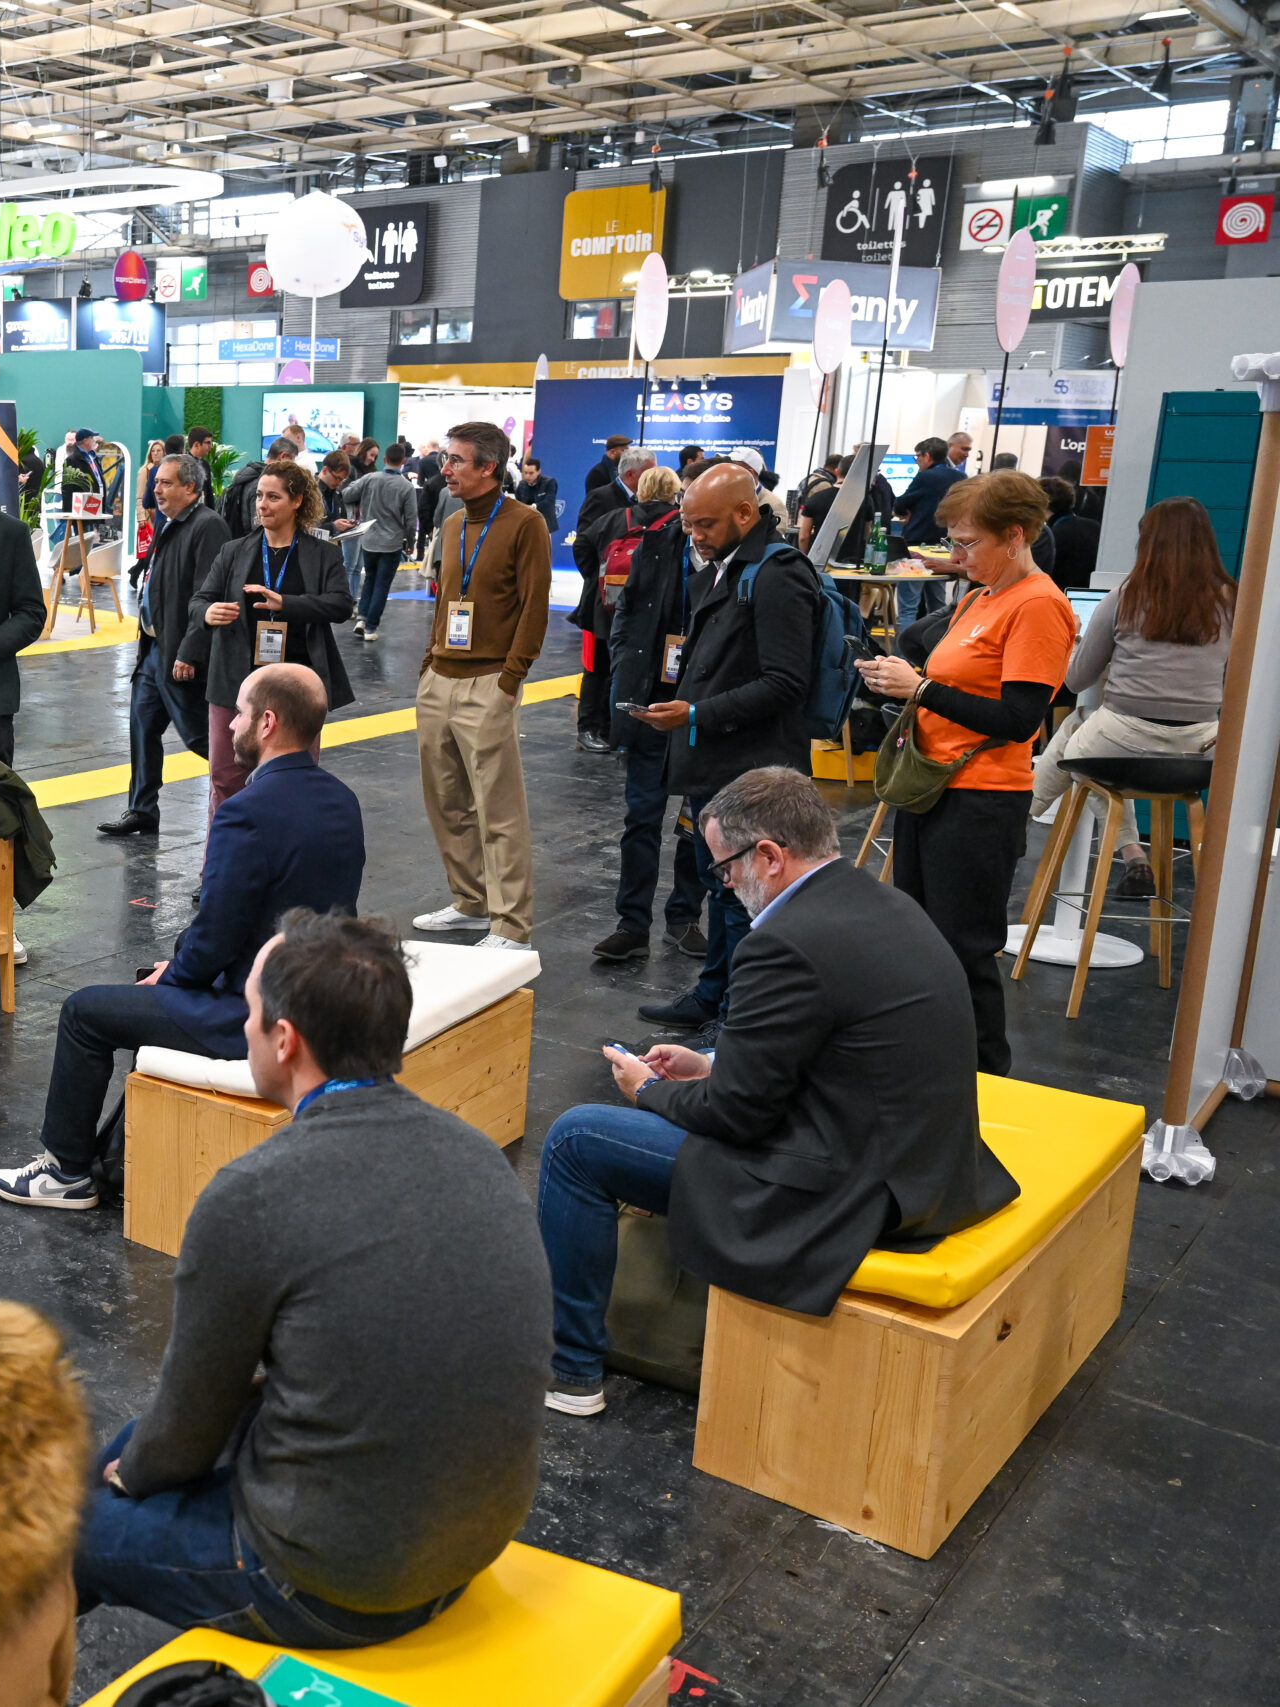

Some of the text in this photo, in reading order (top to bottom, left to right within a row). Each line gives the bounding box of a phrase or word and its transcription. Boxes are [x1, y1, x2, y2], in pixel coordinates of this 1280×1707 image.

[606, 220, 619, 233] LE
[856, 241, 906, 251] toiletts
[861, 253, 893, 263] toilet
[364, 271, 400, 280] toilettes
[820, 288, 918, 334] anty
[232, 341, 274, 353] HexaDone
[294, 340, 336, 352] HexDone
[565, 362, 576, 374] LE
[636, 393, 733, 411] LEASYS
[670, 415, 700, 424] Mobility
[702, 414, 731, 422] Choice
